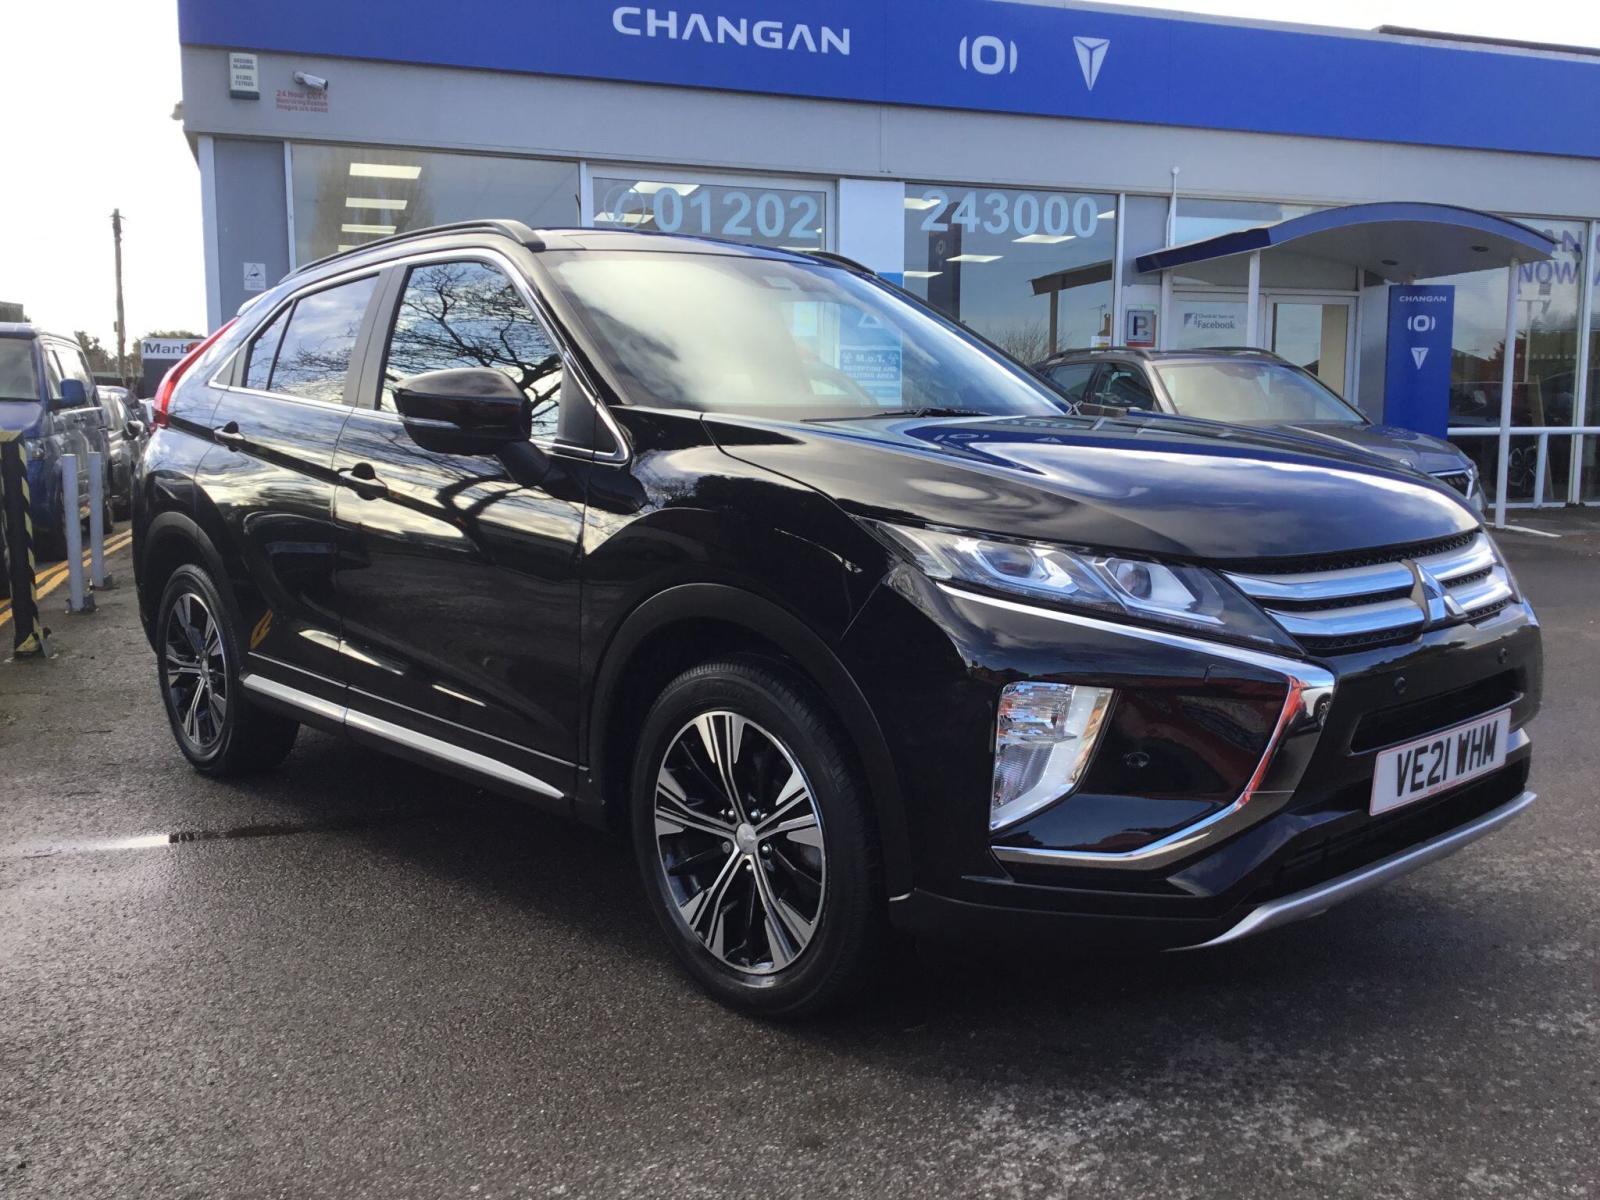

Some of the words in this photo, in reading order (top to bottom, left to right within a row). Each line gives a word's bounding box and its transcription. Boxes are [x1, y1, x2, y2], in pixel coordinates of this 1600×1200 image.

[612, 6, 851, 56] CHANGAN
[652, 191, 820, 239] 01202
[920, 188, 1098, 238] 243000
[1518, 261, 1579, 284] NOW
[1399, 295, 1447, 303] CHANGAN
[1197, 319, 1236, 329] Facebook
[1397, 736, 1451, 797] VE21
[1456, 720, 1498, 776] WHM
